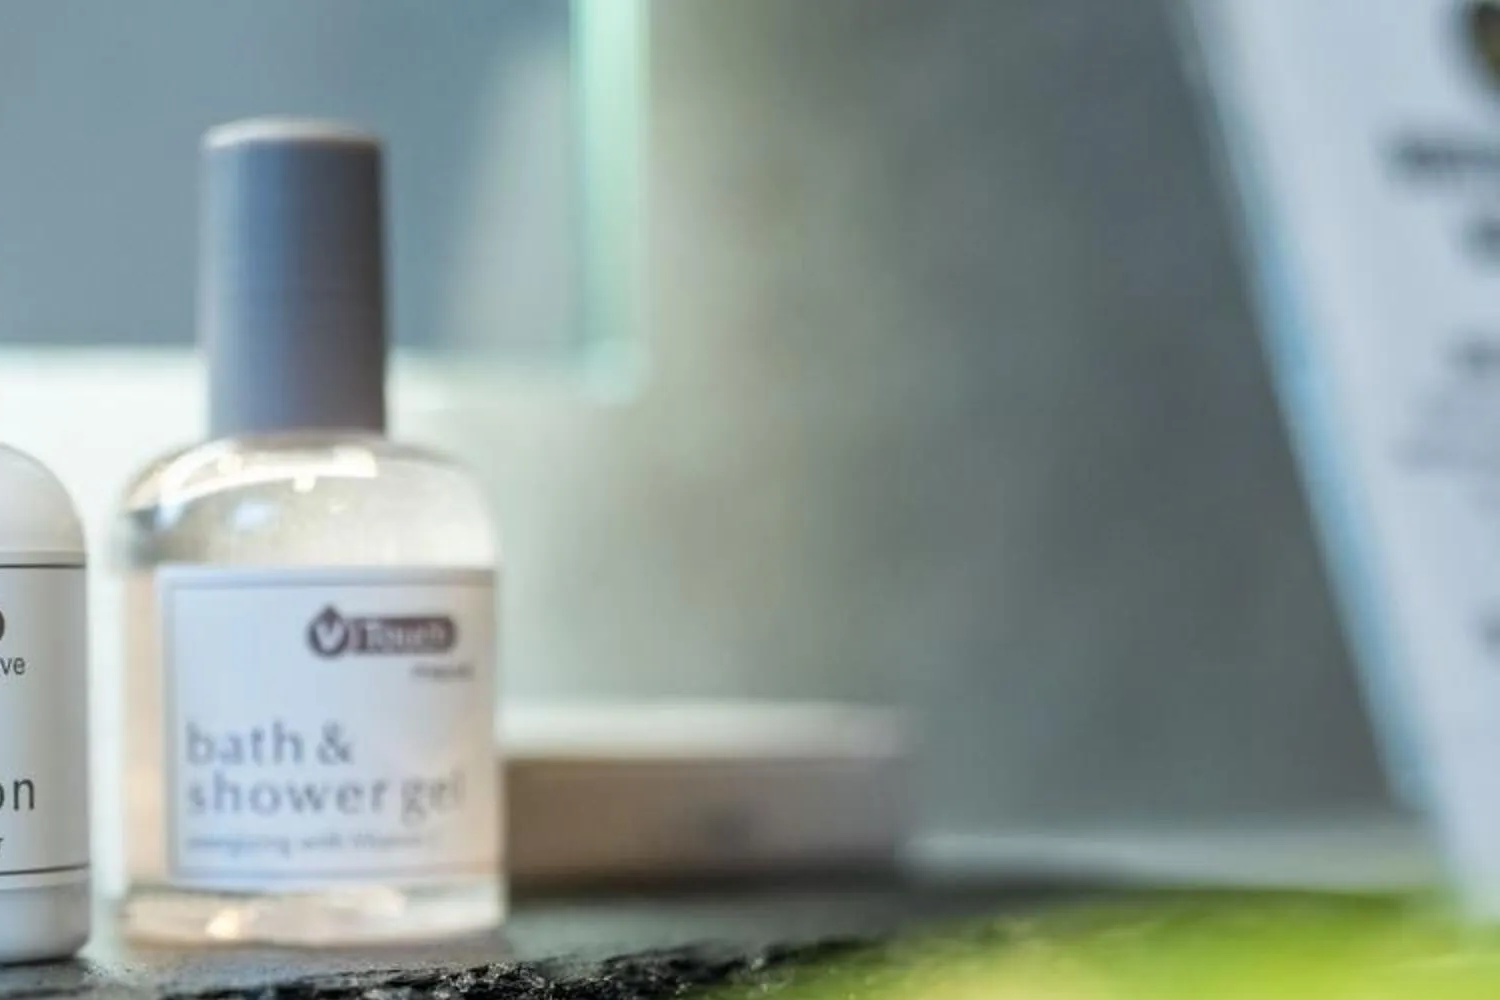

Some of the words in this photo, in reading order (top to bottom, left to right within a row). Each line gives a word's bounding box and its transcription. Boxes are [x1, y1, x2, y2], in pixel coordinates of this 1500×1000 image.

[314, 620, 346, 652] V
[185, 719, 305, 767] bath
[315, 720, 354, 767] &
[187, 768, 389, 817] shower
